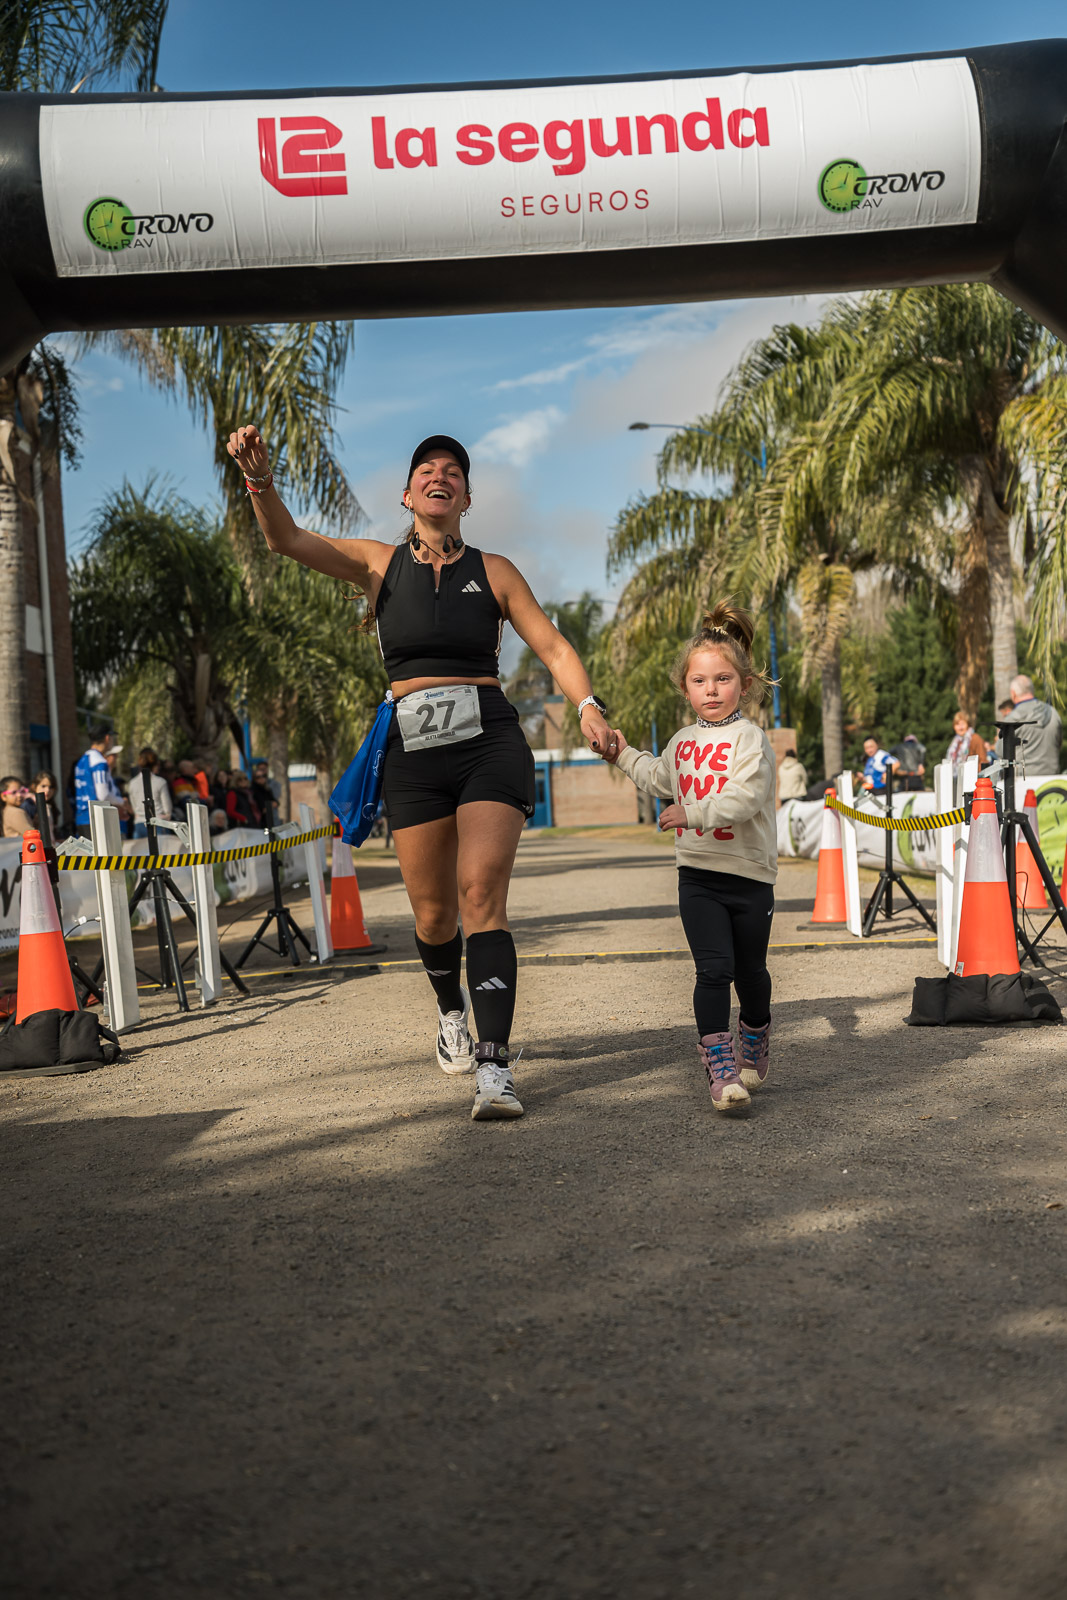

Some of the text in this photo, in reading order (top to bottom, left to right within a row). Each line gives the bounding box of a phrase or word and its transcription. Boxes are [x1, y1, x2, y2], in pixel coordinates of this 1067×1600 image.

[371, 97, 770, 176] la segunda
[853, 170, 945, 196] CRONO
[501, 189, 650, 217] SEGUROS
[850, 198, 883, 210] RAV
[121, 212, 214, 235] CRONO
[121, 238, 154, 249] RAV
[416, 700, 456, 734] 27
[675, 740, 732, 771] LOVE
